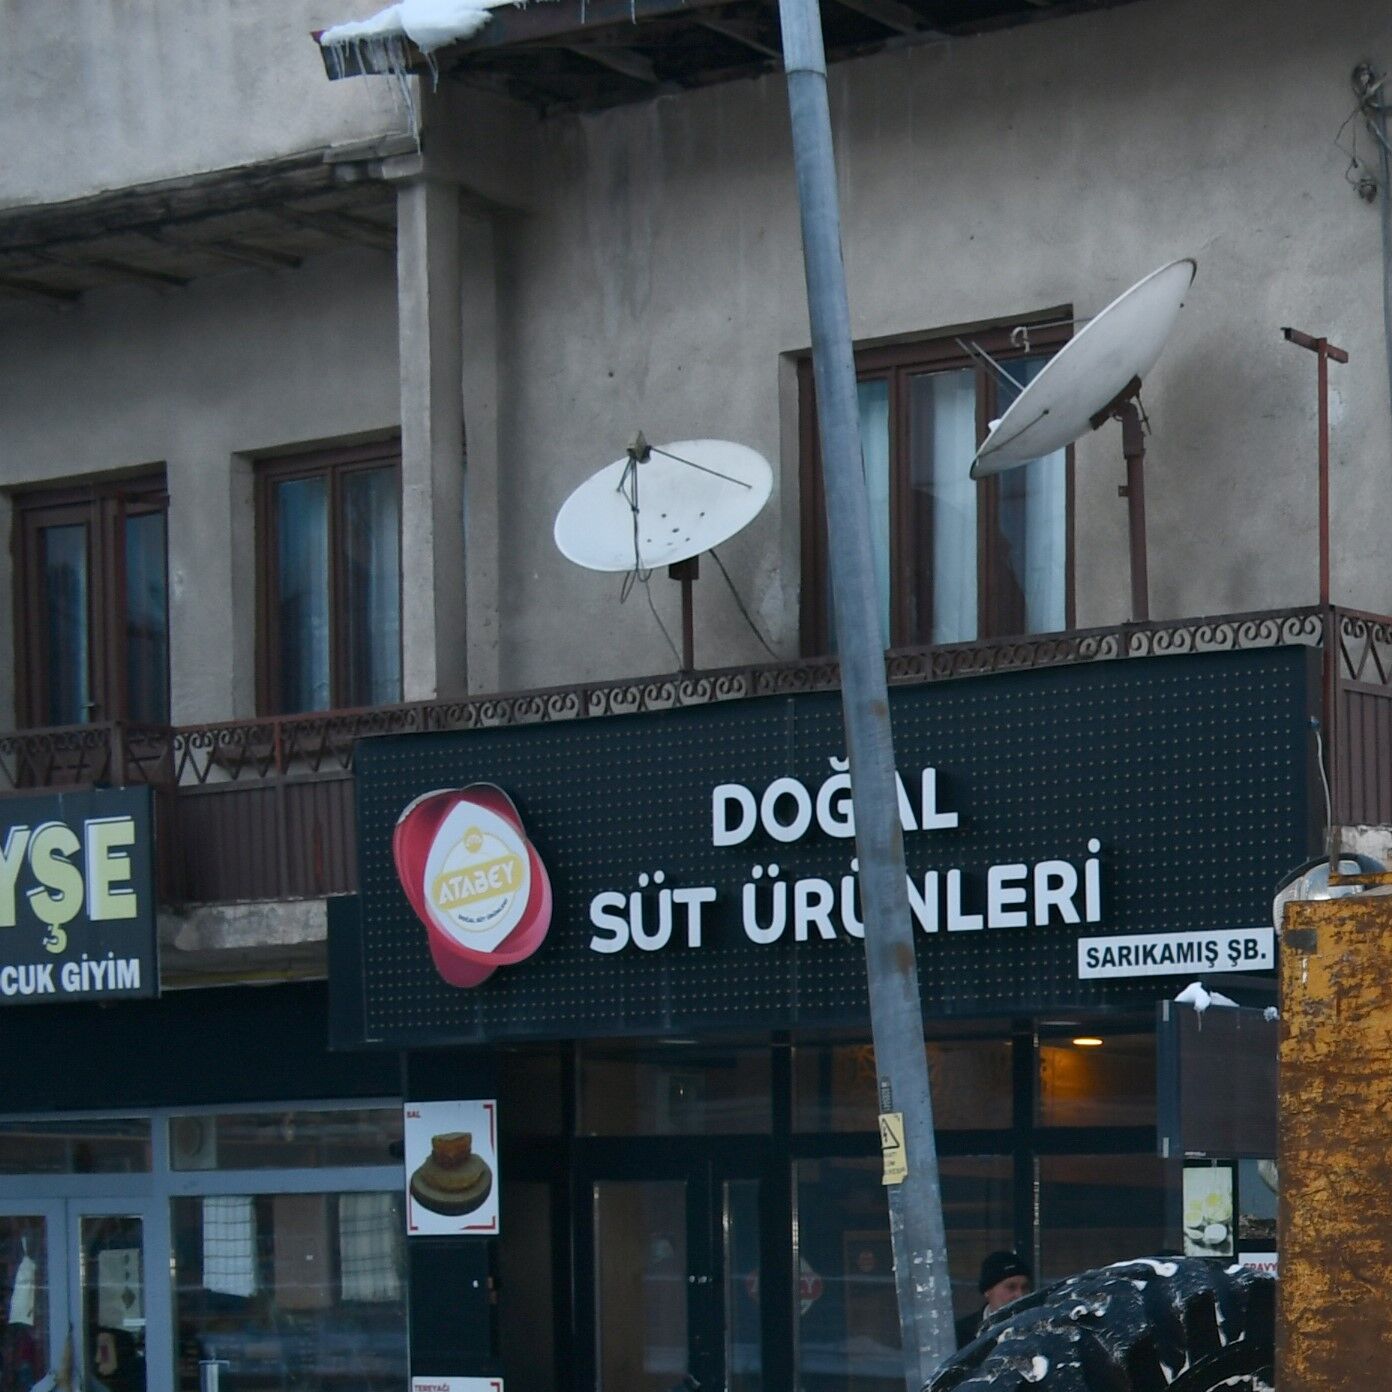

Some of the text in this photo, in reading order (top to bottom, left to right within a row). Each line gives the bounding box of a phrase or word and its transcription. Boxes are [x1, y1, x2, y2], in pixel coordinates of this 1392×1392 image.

[439, 861, 514, 905] ATABEY
[590, 869, 717, 953] SÜT
[61, 951, 141, 992] GİYİM
[1086, 938, 1267, 969] SARIKAMIŞ ŞB.
[414, 1382, 450, 1392] TEREYAĞI
